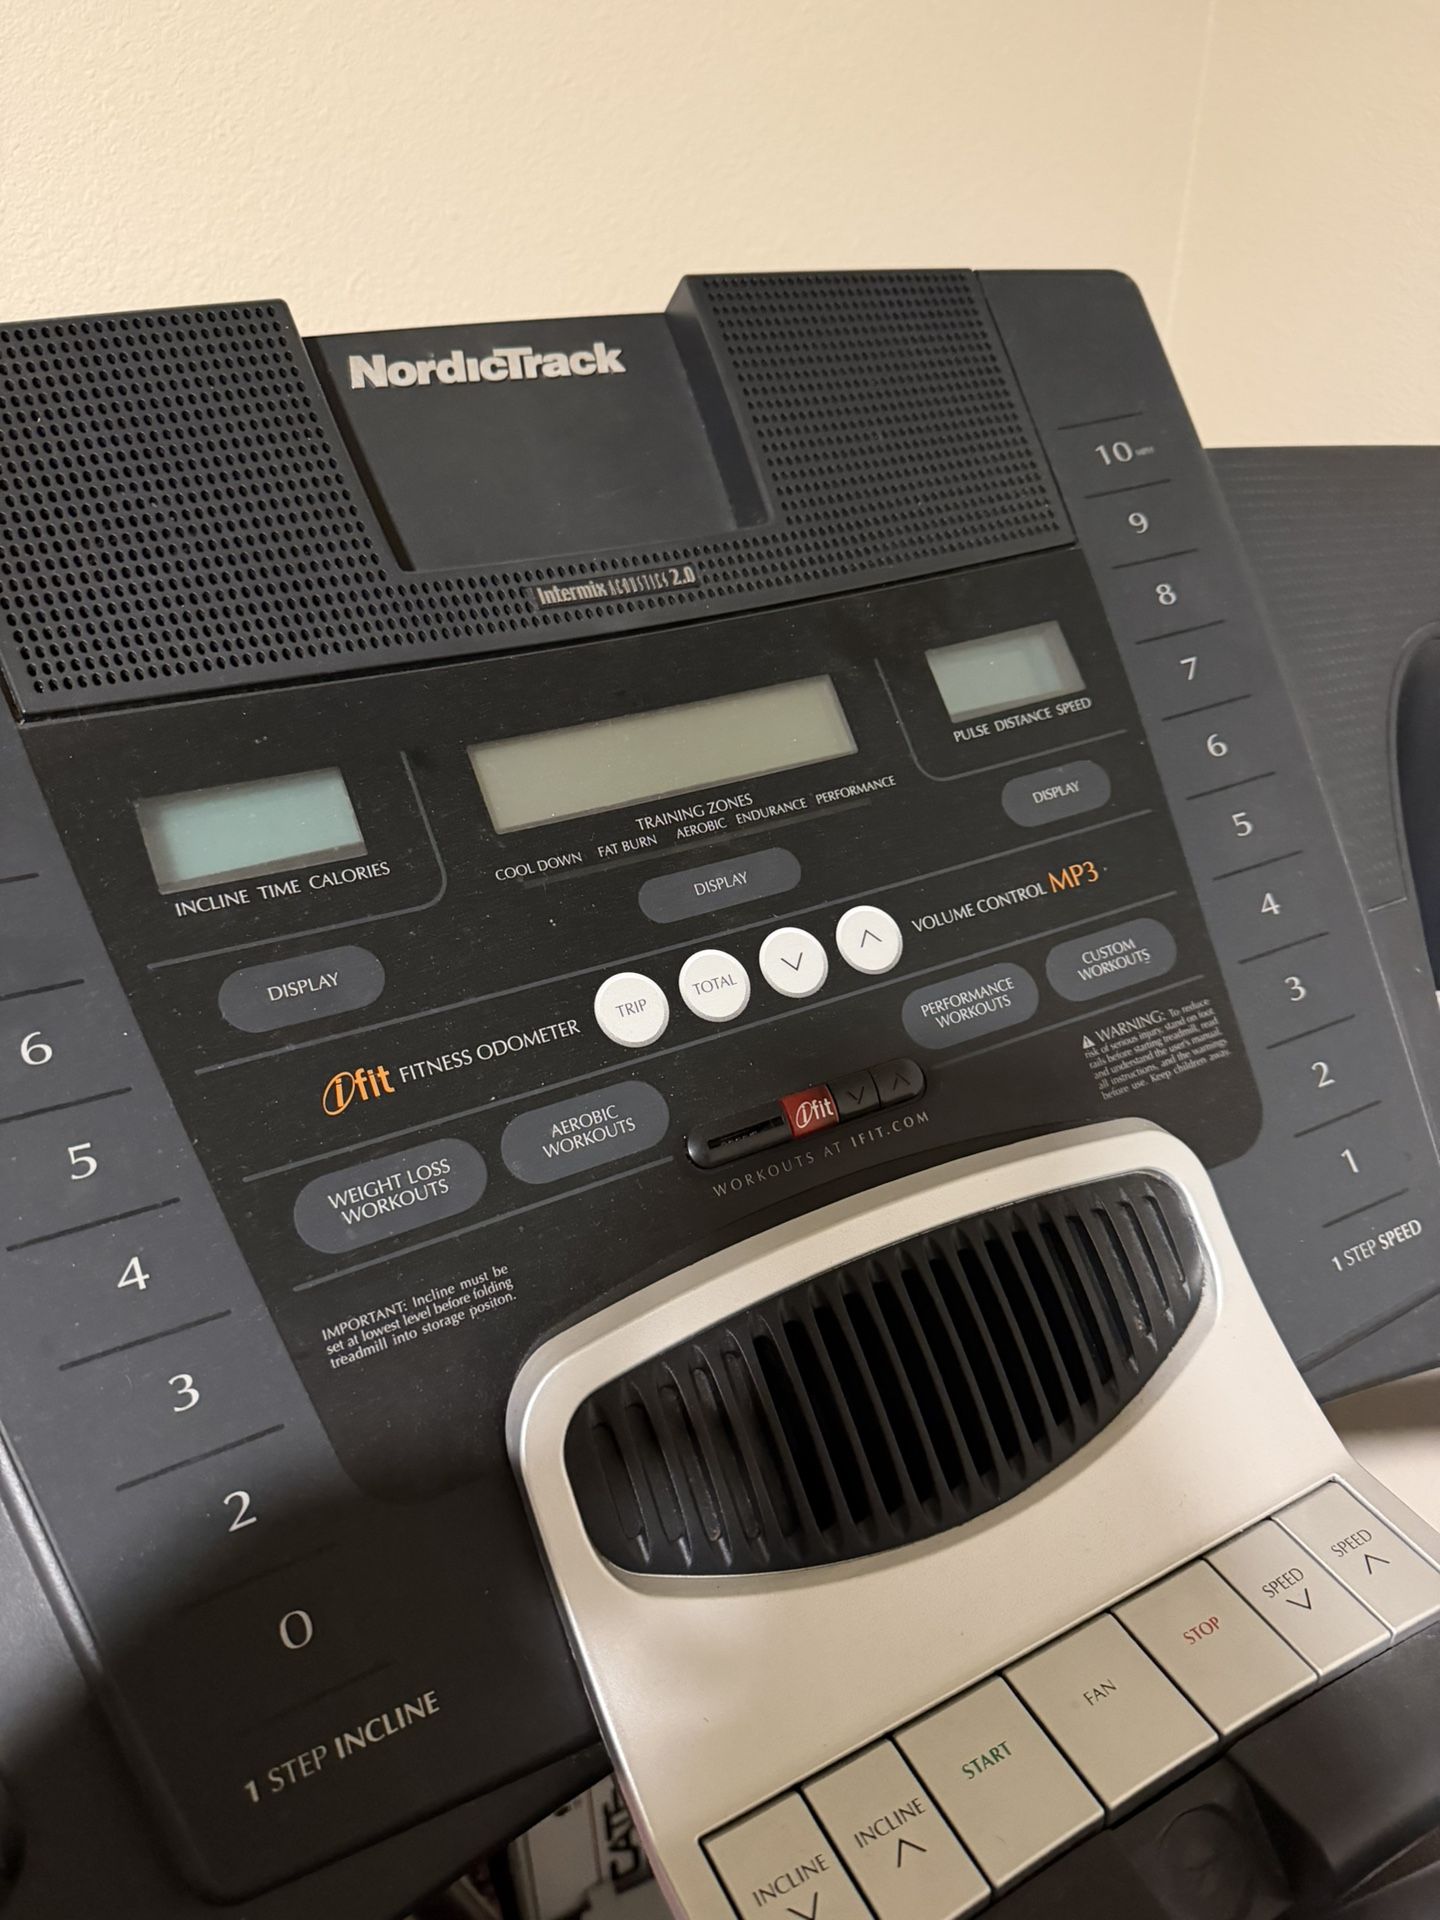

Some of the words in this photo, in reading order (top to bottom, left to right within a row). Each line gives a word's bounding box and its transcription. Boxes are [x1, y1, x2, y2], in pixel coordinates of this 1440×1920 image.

[348, 341, 626, 390] NordicTrack
[1094, 441, 1133, 466] 10
[1128, 512, 1149, 534] 9
[536, 580, 608, 605] Intermix
[608, 571, 669, 596] ACOUSTICS
[668, 566, 697, 586] 2.0
[1155, 583, 1177, 606] 8
[1179, 656, 1198, 681] 7
[953, 723, 990, 743] PULSE
[993, 707, 1053, 732] DISTANCE
[1055, 697, 1092, 716] SPEED
[1206, 733, 1229, 757] 6
[814, 775, 897, 806] PERFORMANCE
[1032, 780, 1080, 804] DISPLAY
[635, 804, 705, 832] TRAINING
[705, 793, 754, 818] ZONES
[676, 817, 728, 839] AEROBIC
[736, 797, 808, 825] ENDURANCE
[1231, 811, 1254, 837] 5
[597, 841, 621, 858] FAT
[621, 835, 658, 854] BURN
[494, 860, 535, 883] COOL
[536, 851, 583, 873] DOWN
[693, 871, 748, 897] DISPLAY
[174, 889, 251, 918] INCLINE
[256, 879, 302, 900] TIME
[308, 861, 391, 890] CALORIES
[910, 902, 977, 932] VOLUME
[976, 882, 1048, 914] CONTROL
[1047, 861, 1100, 894] MP3
[1260, 892, 1281, 915] 4
[1077, 948, 1151, 981] WORKOUTS
[1081, 938, 1136, 965] CUSTOM
[266, 971, 339, 1002] DISPLAY
[692, 973, 738, 996] TOTAL
[920, 976, 1015, 1018] PERFORMANCE
[1284, 976, 1307, 1002] 3
[615, 998, 648, 1018] TRIP
[935, 994, 1012, 1030] WORKOUTS
[1095, 1010, 1167, 1042] WARNING:
[1168, 1008, 1181, 1018] To
[1181, 999, 1210, 1014] reduce
[20, 1031, 53, 1066] 6
[399, 1049, 473, 1084] FITNESS
[476, 1018, 581, 1060] ODOMETER
[1084, 1047, 1100, 1059] risk
[1101, 1044, 1110, 1054] of
[1110, 1036, 1138, 1051] serious
[1164, 1018, 1186, 1031] stand
[1186, 1014, 1198, 1024] on
[1088, 1058, 1107, 1069] rails
[1106, 1049, 1133, 1063] before
[1133, 1039, 1163, 1054] starting
[1200, 1016, 1220, 1029] read
[1094, 1066, 1110, 1080] and
[1110, 1053, 1154, 1074] understand
[1154, 1046, 1168, 1058] the
[1099, 1079, 1109, 1090] all
[1160, 1054, 1177, 1067] and
[1176, 1050, 1191, 1061] the
[1101, 1085, 1129, 1101] before
[1149, 1070, 1172, 1083] Keep
[1173, 1056, 1207, 1075] children
[1311, 1061, 1336, 1088] 2
[542, 1117, 636, 1159] WORKOUTS
[550, 1104, 619, 1138] AEROBIC
[67, 1142, 98, 1181] 5
[712, 1152, 815, 1198] WORKOUTS
[823, 1141, 842, 1158] AT
[850, 1111, 930, 1149] IFIT.COM
[1340, 1148, 1360, 1174] 1
[327, 1173, 402, 1210] WEIGHT
[405, 1158, 451, 1185] LOSS
[341, 1179, 450, 1225] WORKOUTS
[1331, 1255, 1344, 1272] 1
[1343, 1239, 1377, 1267] STEP
[1377, 1219, 1423, 1252] SPEED
[117, 1256, 150, 1291] 4
[321, 1300, 408, 1341] IMPORTANT:
[411, 1284, 456, 1308] Incline
[459, 1271, 489, 1291] must
[492, 1264, 509, 1278] be
[326, 1341, 345, 1356] set
[347, 1335, 360, 1348] at
[361, 1318, 401, 1342] lowest
[402, 1306, 432, 1327] level
[434, 1293, 471, 1315] before
[472, 1278, 515, 1300] folding
[330, 1336, 388, 1369] treadmill
[391, 1328, 418, 1346] into
[421, 1311, 466, 1335] storage
[469, 1292, 517, 1320] positon.
[167, 1373, 200, 1412] 3
[223, 1490, 257, 1532] 2
[1330, 1528, 1373, 1558] SPEED
[1261, 1567, 1304, 1599] SPEED
[1183, 1616, 1221, 1646] STOP
[1082, 1678, 1117, 1707] FAN
[244, 1779, 261, 1804] 1
[267, 1745, 328, 1793] STEP
[333, 1690, 441, 1760] INCLINE
[961, 1740, 1013, 1780] START
[853, 1797, 927, 1849] INCLINE
[752, 1853, 830, 1908] INCLINE
